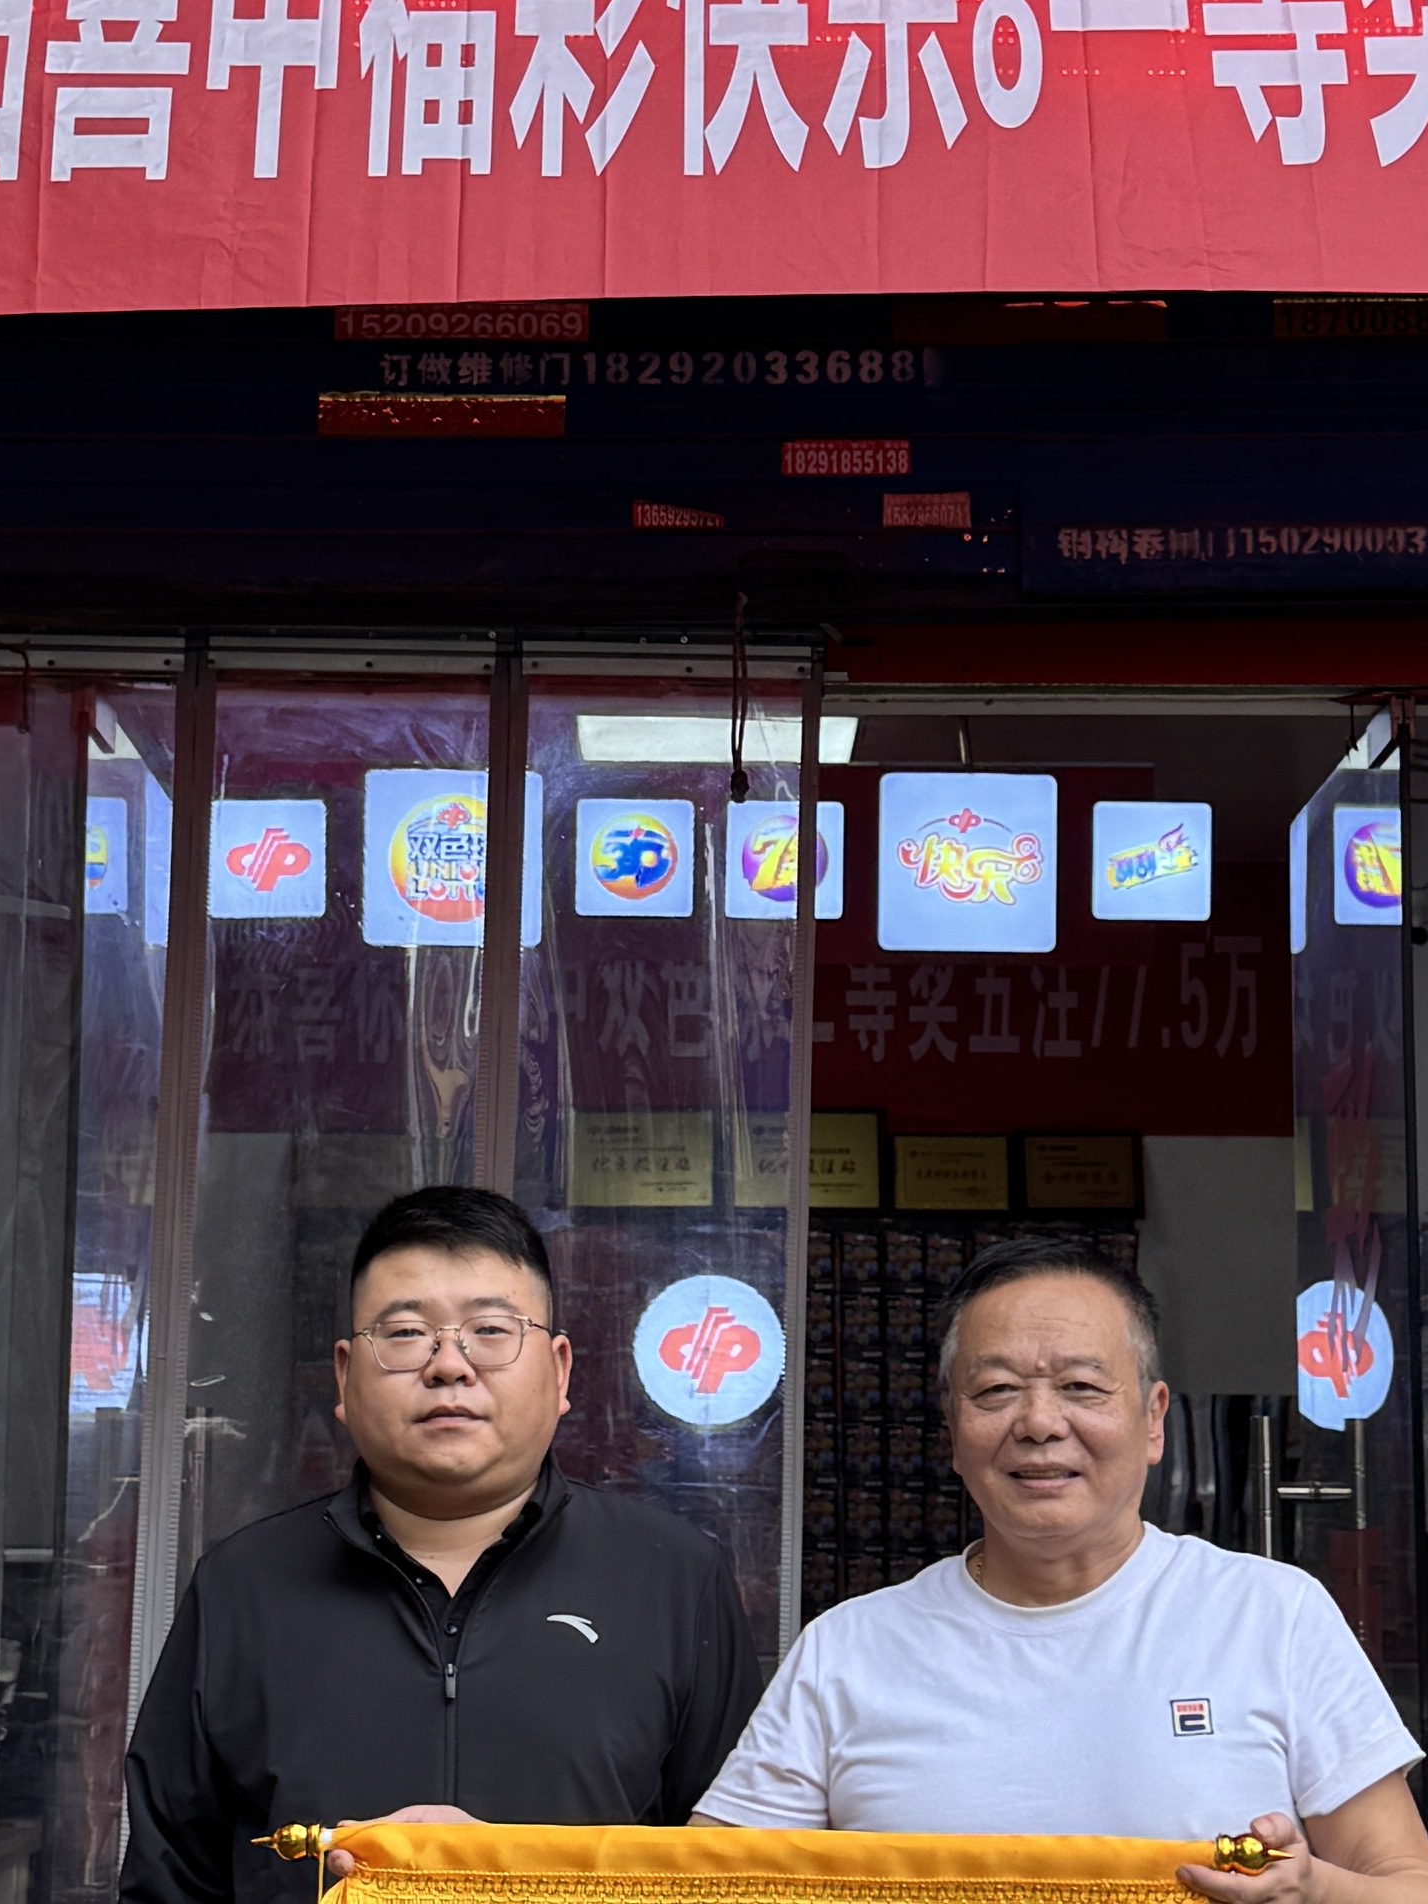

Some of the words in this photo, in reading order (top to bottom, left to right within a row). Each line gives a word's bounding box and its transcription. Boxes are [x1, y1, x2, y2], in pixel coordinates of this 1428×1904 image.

[338, 311, 585, 339] 15209266069
[782, 448, 911, 476] 18291855138
[407, 860, 486, 881] UNIO
